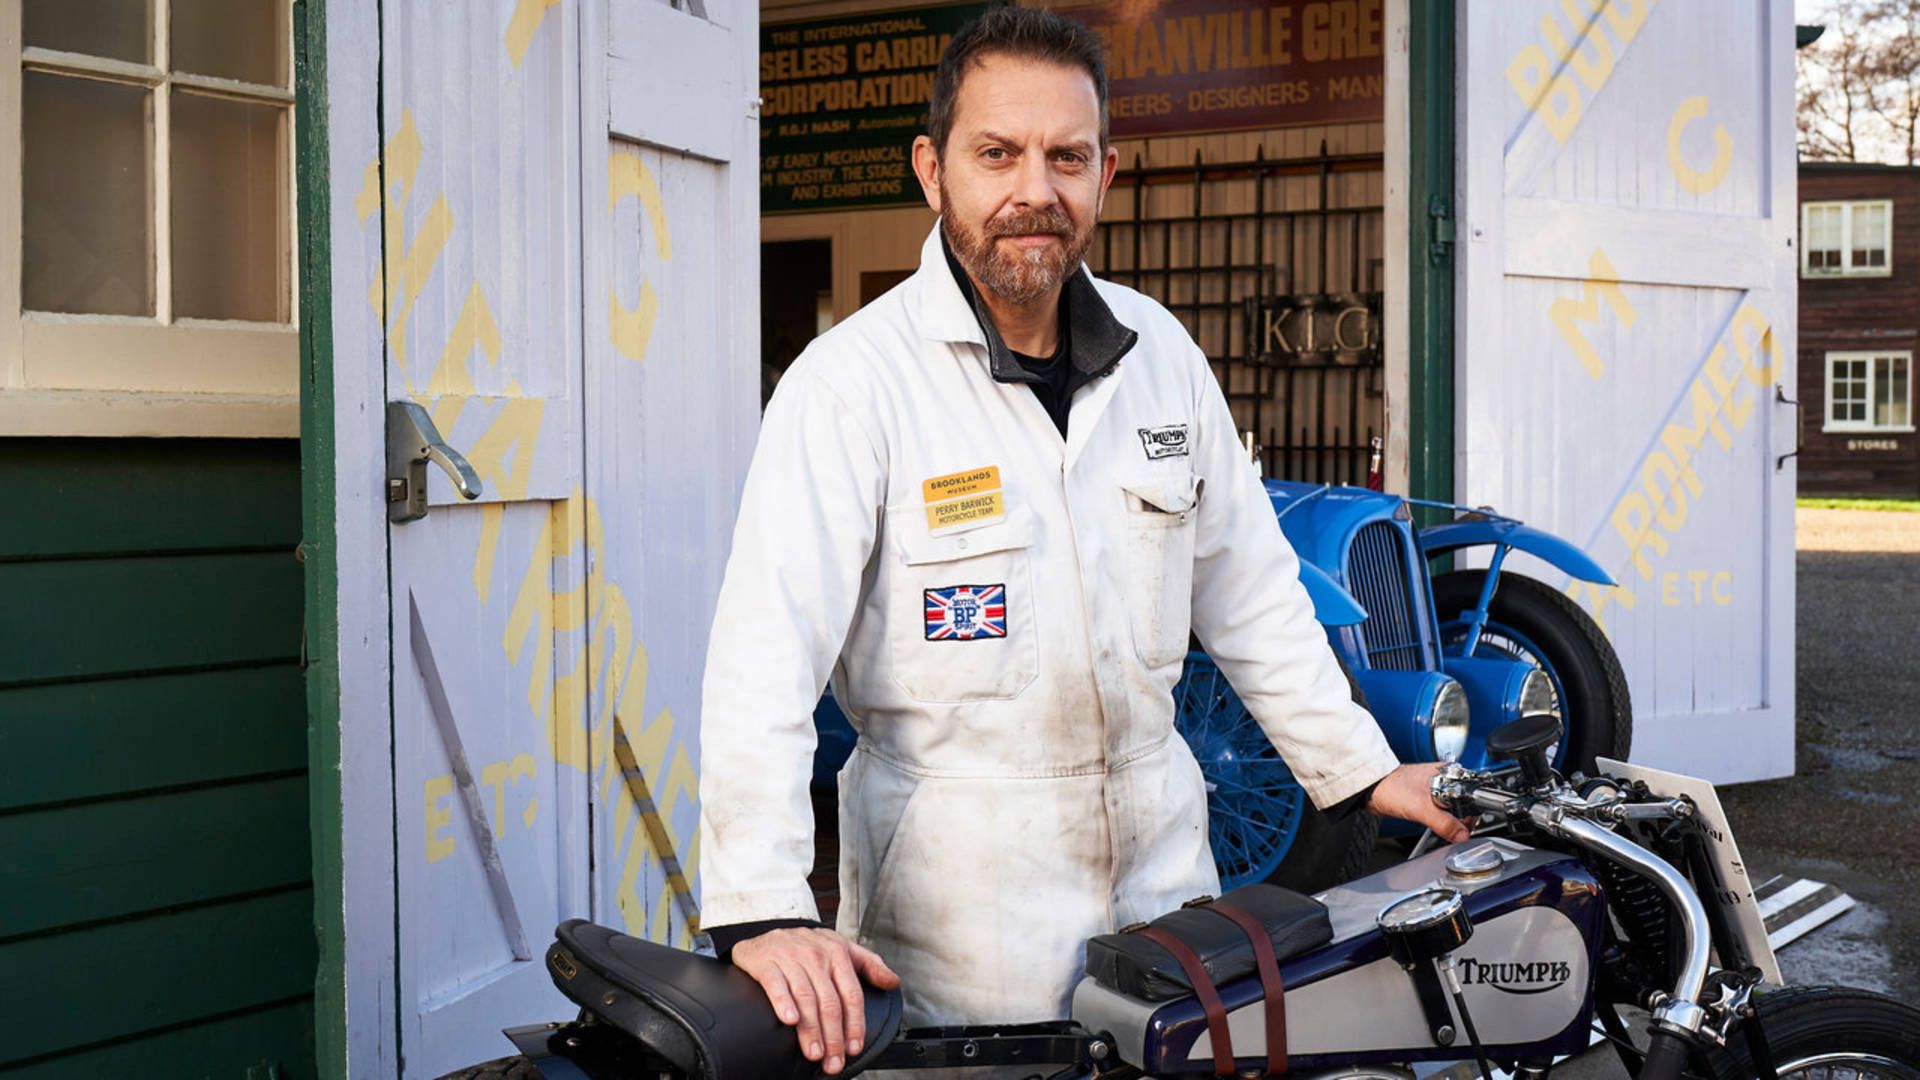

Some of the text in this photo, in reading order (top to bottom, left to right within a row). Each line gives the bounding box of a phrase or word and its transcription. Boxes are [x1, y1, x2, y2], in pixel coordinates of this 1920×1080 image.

[772, 18, 927, 45] THE INTERNATIONAL
[760, 72, 937, 116] CORPORATION
[1187, 80, 1310, 112] DESIGNERS
[824, 147, 906, 165] MECHANICAL
[841, 166, 864, 180] THE
[866, 163, 906, 179] STAGE
[792, 181, 902, 200] AND EXHIBITIONS
[1611, 302, 1785, 582] ROMEO
[1847, 439, 1899, 451] STORES
[930, 471, 991, 490] BROOKLANDS
[947, 484, 977, 495] MUSEUM
[935, 495, 995, 517] PERRY BARWICK
[938, 506, 994, 525] MOTORCYCLE TEAM
[1662, 571, 1733, 606] ETC
[1459, 957, 1571, 992] TRIUMPH
